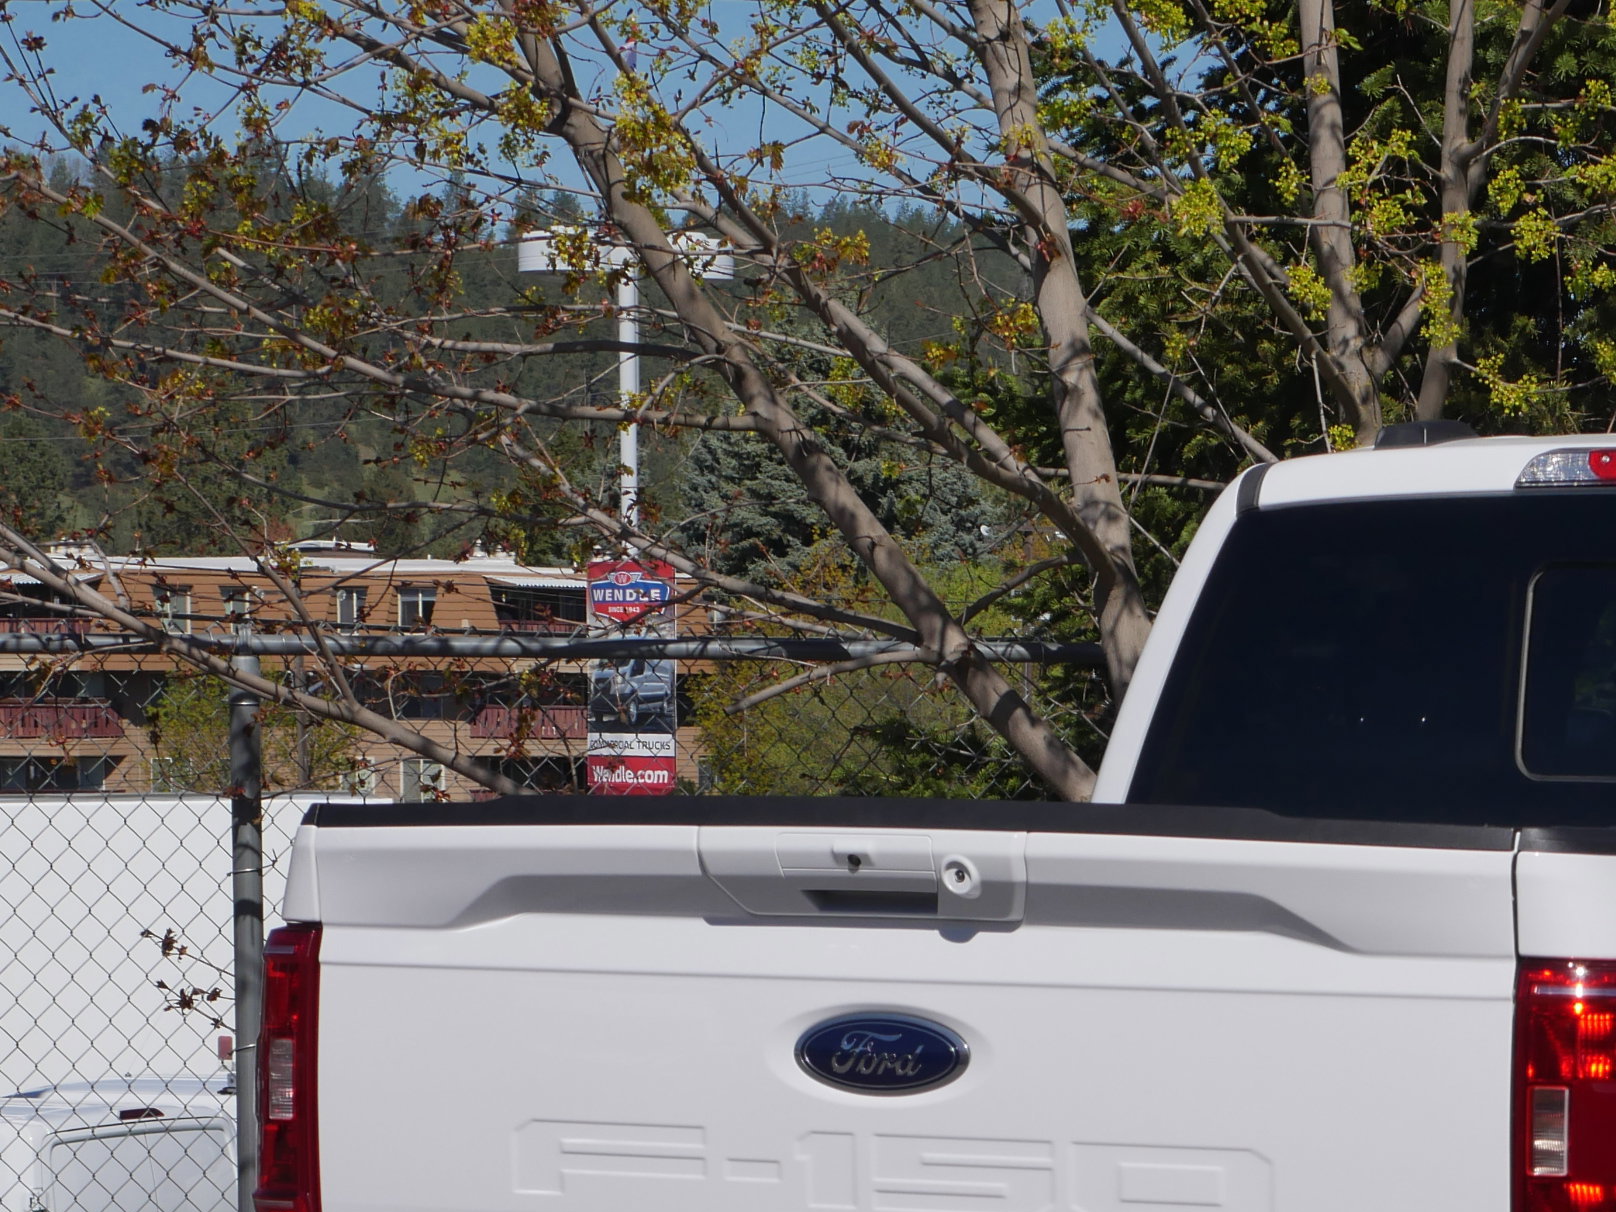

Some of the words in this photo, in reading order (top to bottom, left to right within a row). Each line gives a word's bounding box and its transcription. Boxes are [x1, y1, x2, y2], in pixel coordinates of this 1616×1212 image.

[592, 588, 661, 602] WENDLE
[637, 740, 671, 750] TRUCKS
[831, 1030, 925, 1077] Ford
